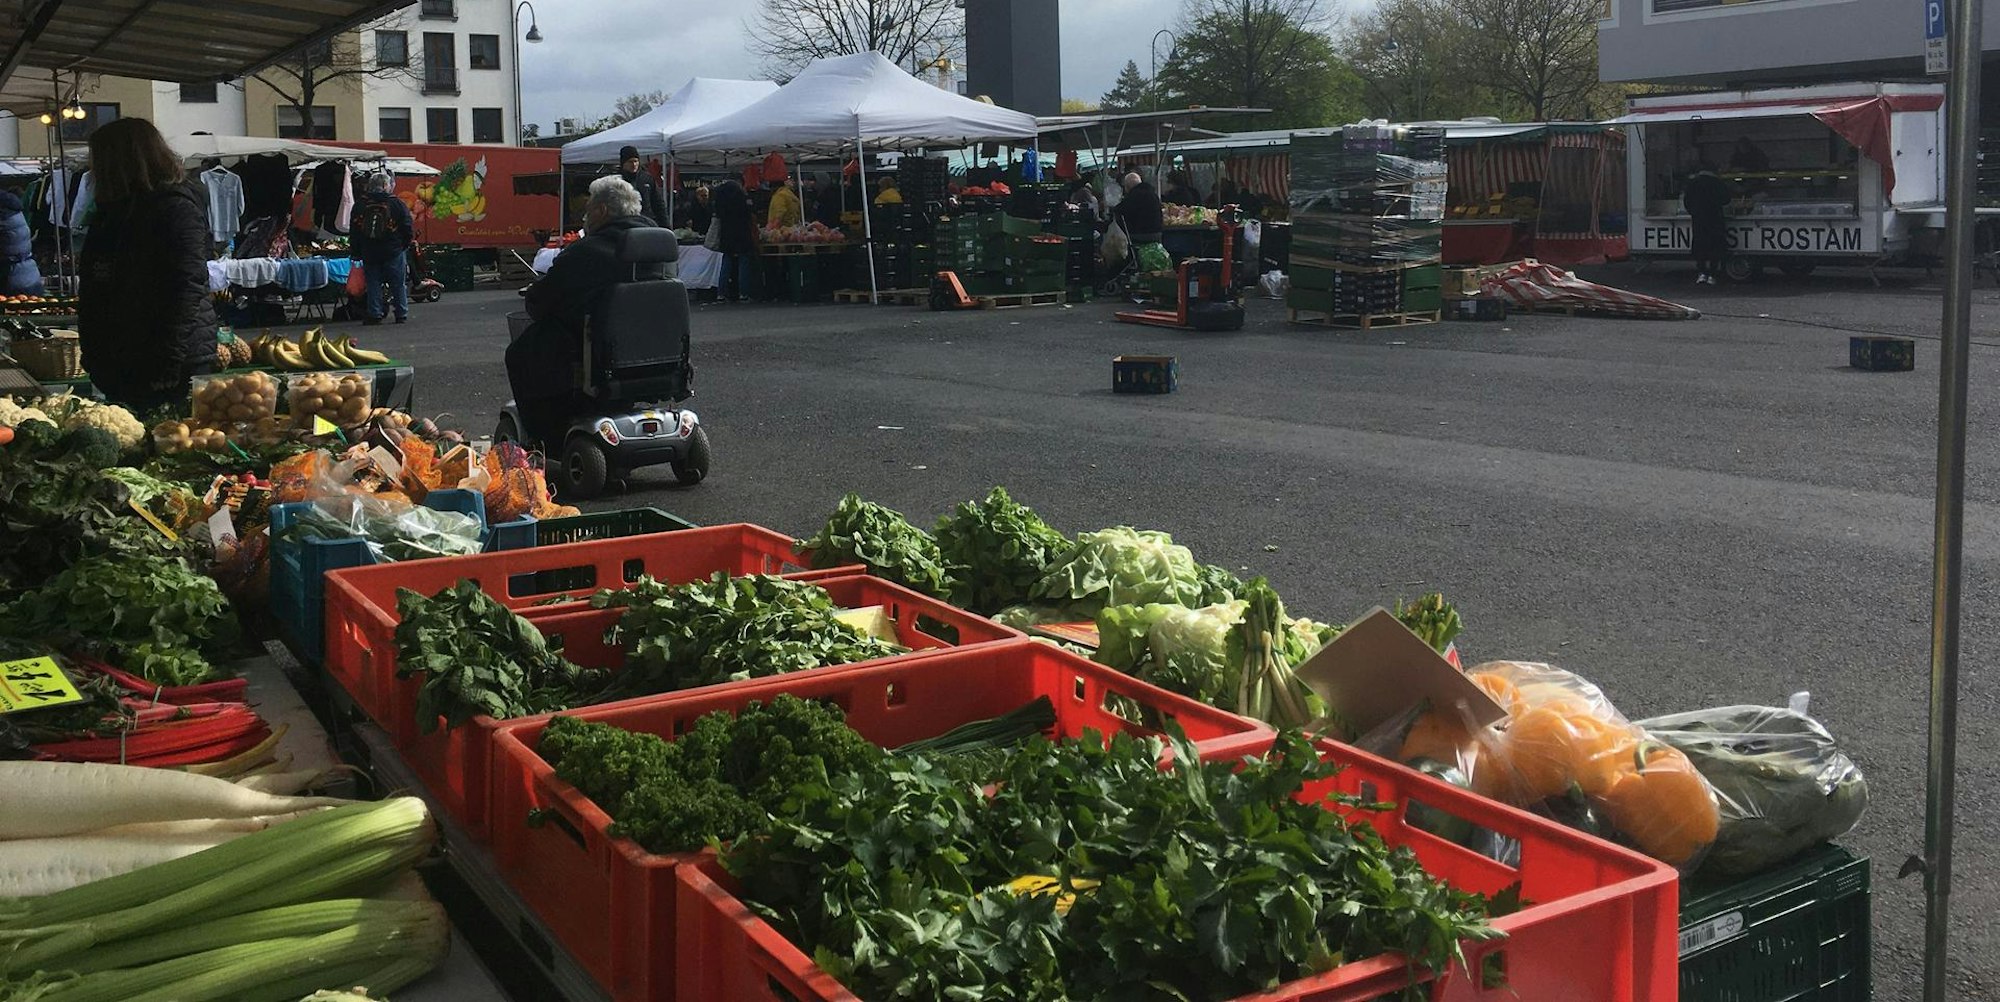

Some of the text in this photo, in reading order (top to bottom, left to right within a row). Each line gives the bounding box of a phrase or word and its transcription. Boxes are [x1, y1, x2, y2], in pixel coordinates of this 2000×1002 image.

[1929, 2, 1940, 34] P
[1644, 226, 1862, 251] FEINST ROSTAM
